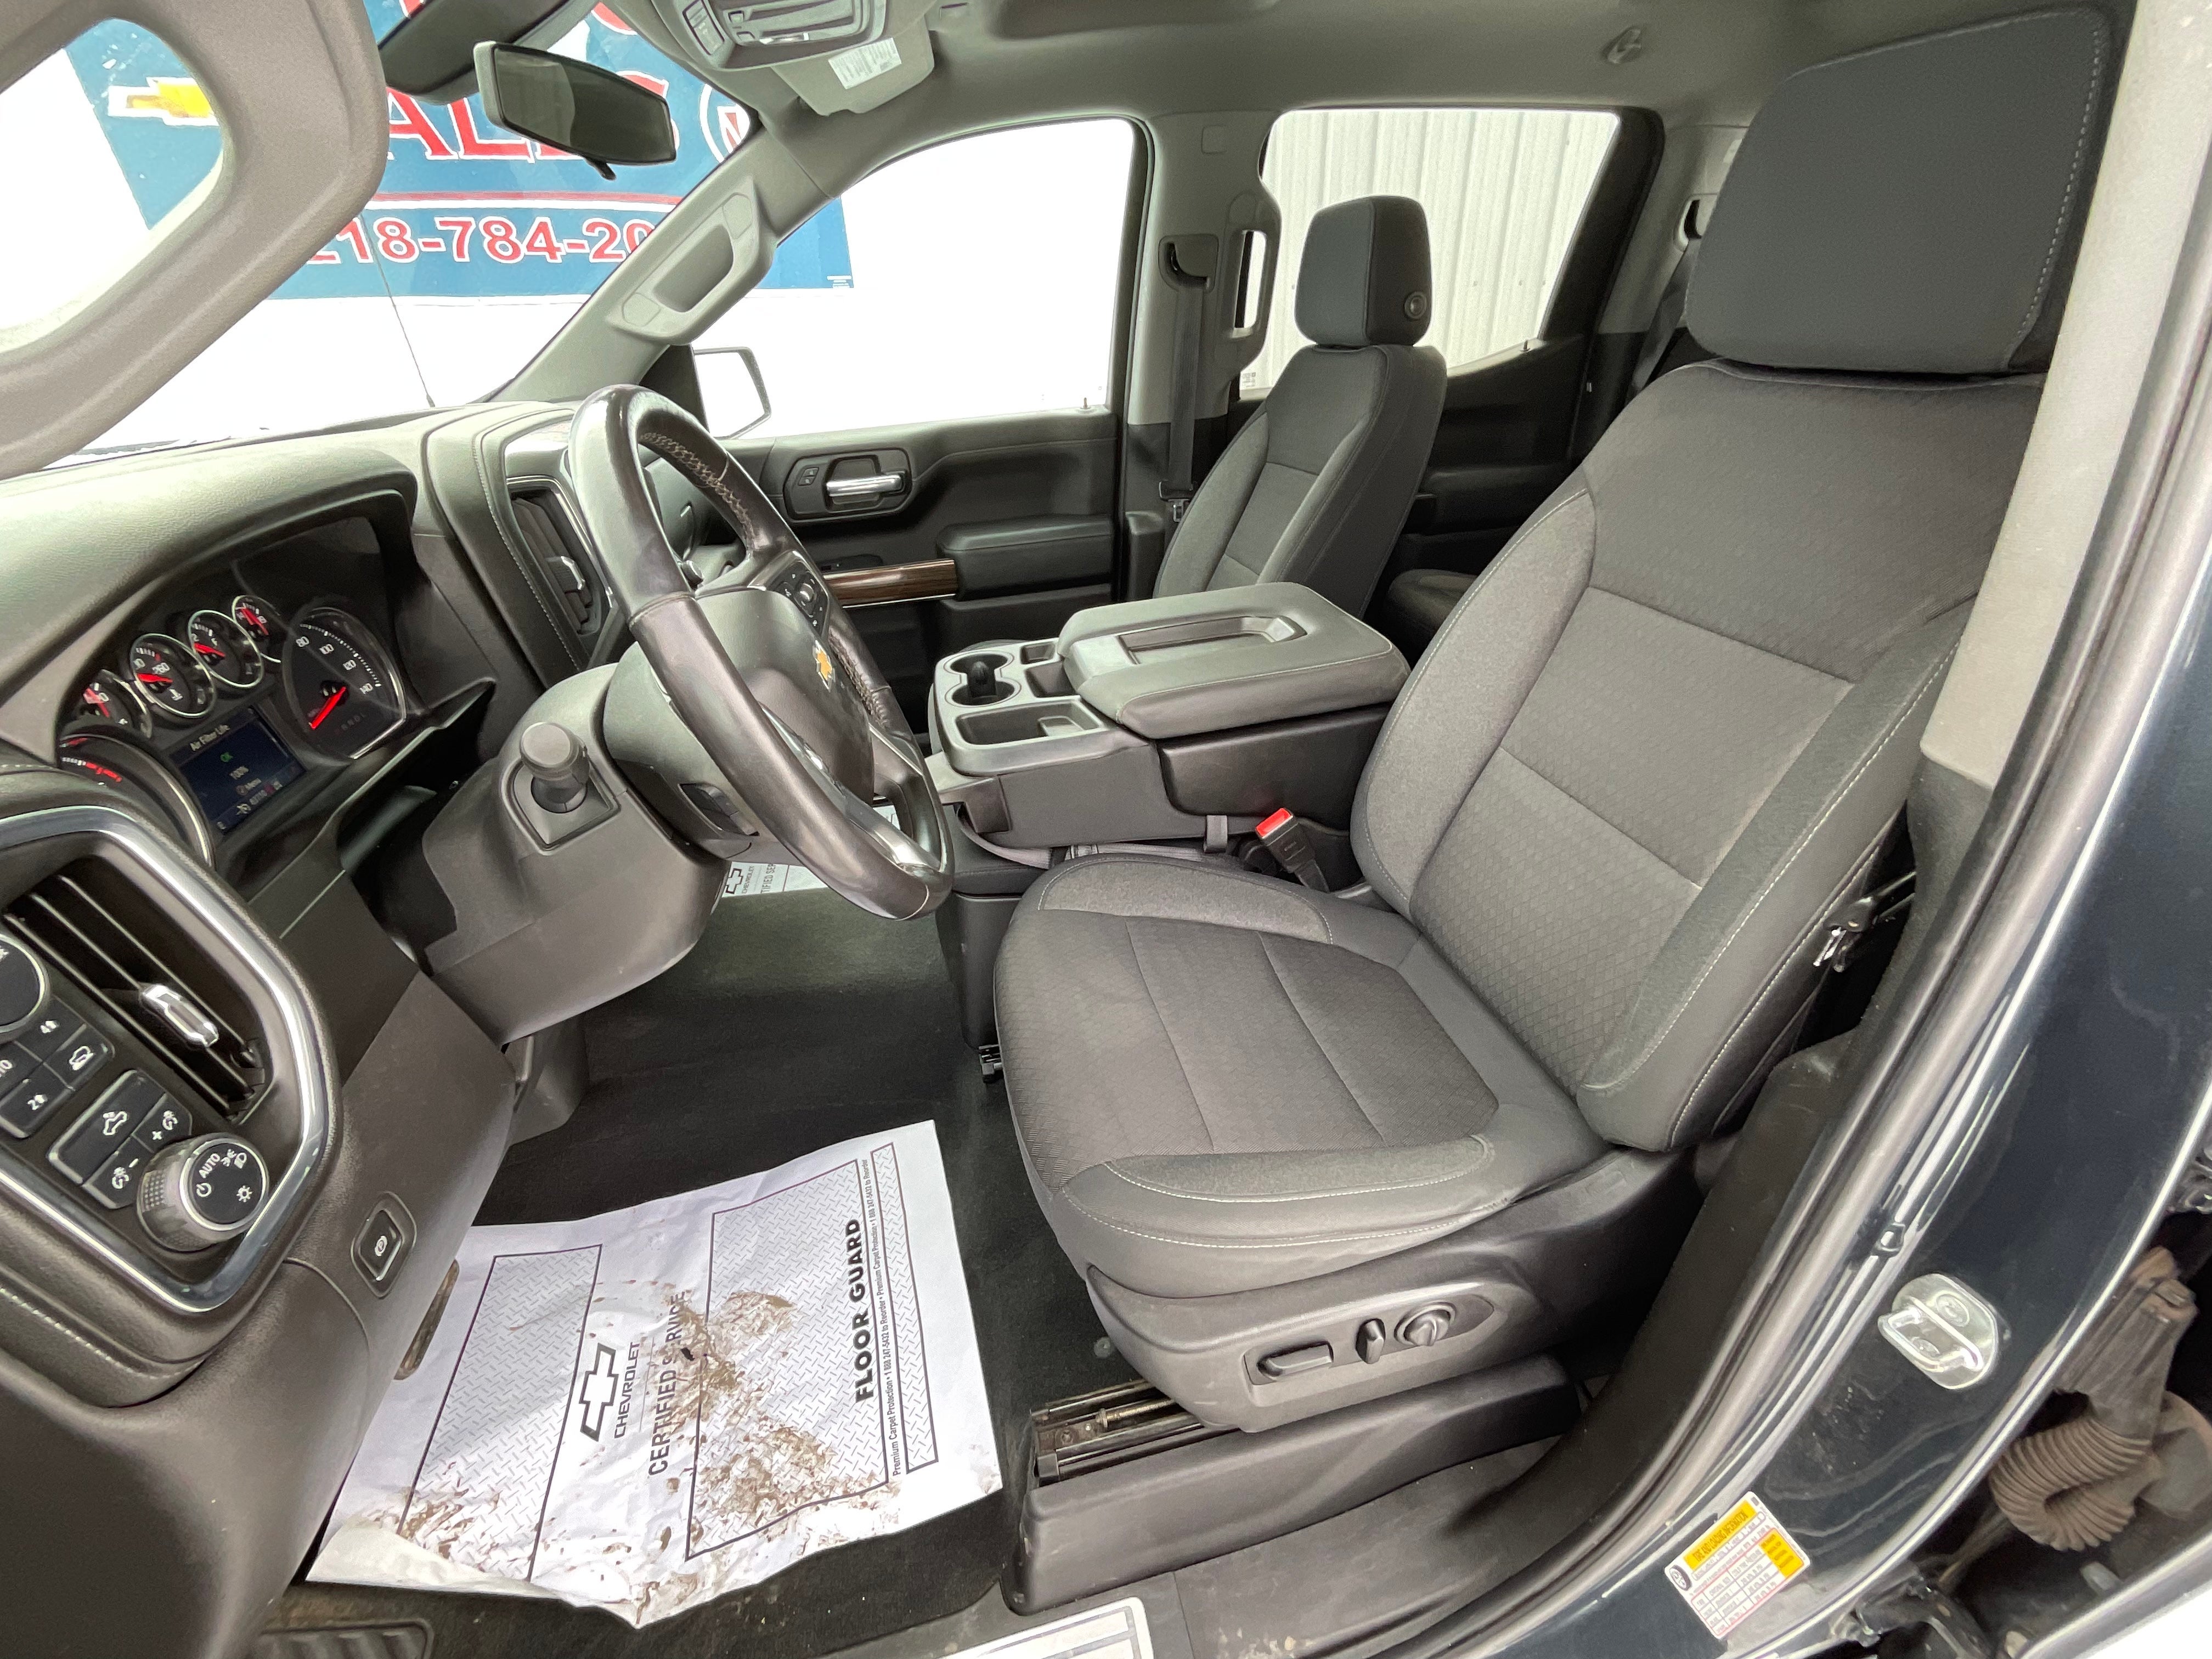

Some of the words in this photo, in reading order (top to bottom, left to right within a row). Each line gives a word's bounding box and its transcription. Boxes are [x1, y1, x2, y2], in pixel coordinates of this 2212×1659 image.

[296, 636, 310, 647] 80
[319, 644, 334, 655] 100
[343, 659, 357, 670] 120
[198, 1153, 221, 1178] AUTO
[861, 1159, 871, 1180] Reorder
[871, 1226, 879, 1252] Protection
[845, 1218, 865, 1303] GUARD
[872, 1250, 882, 1269] Carpet
[875, 1269, 884, 1296] Premium
[879, 1300, 888, 1325] Reorder
[852, 1307, 874, 1403] FLOOR
[881, 1331, 891, 1359] 247-5432
[614, 1342, 640, 1438] CHEVROLET
[886, 1380, 895, 1415] Protection
[648, 1370, 677, 1476] CERTIFIED
[888, 1415, 899, 1440] Carpet
[892, 1441, 901, 1476] Premium
